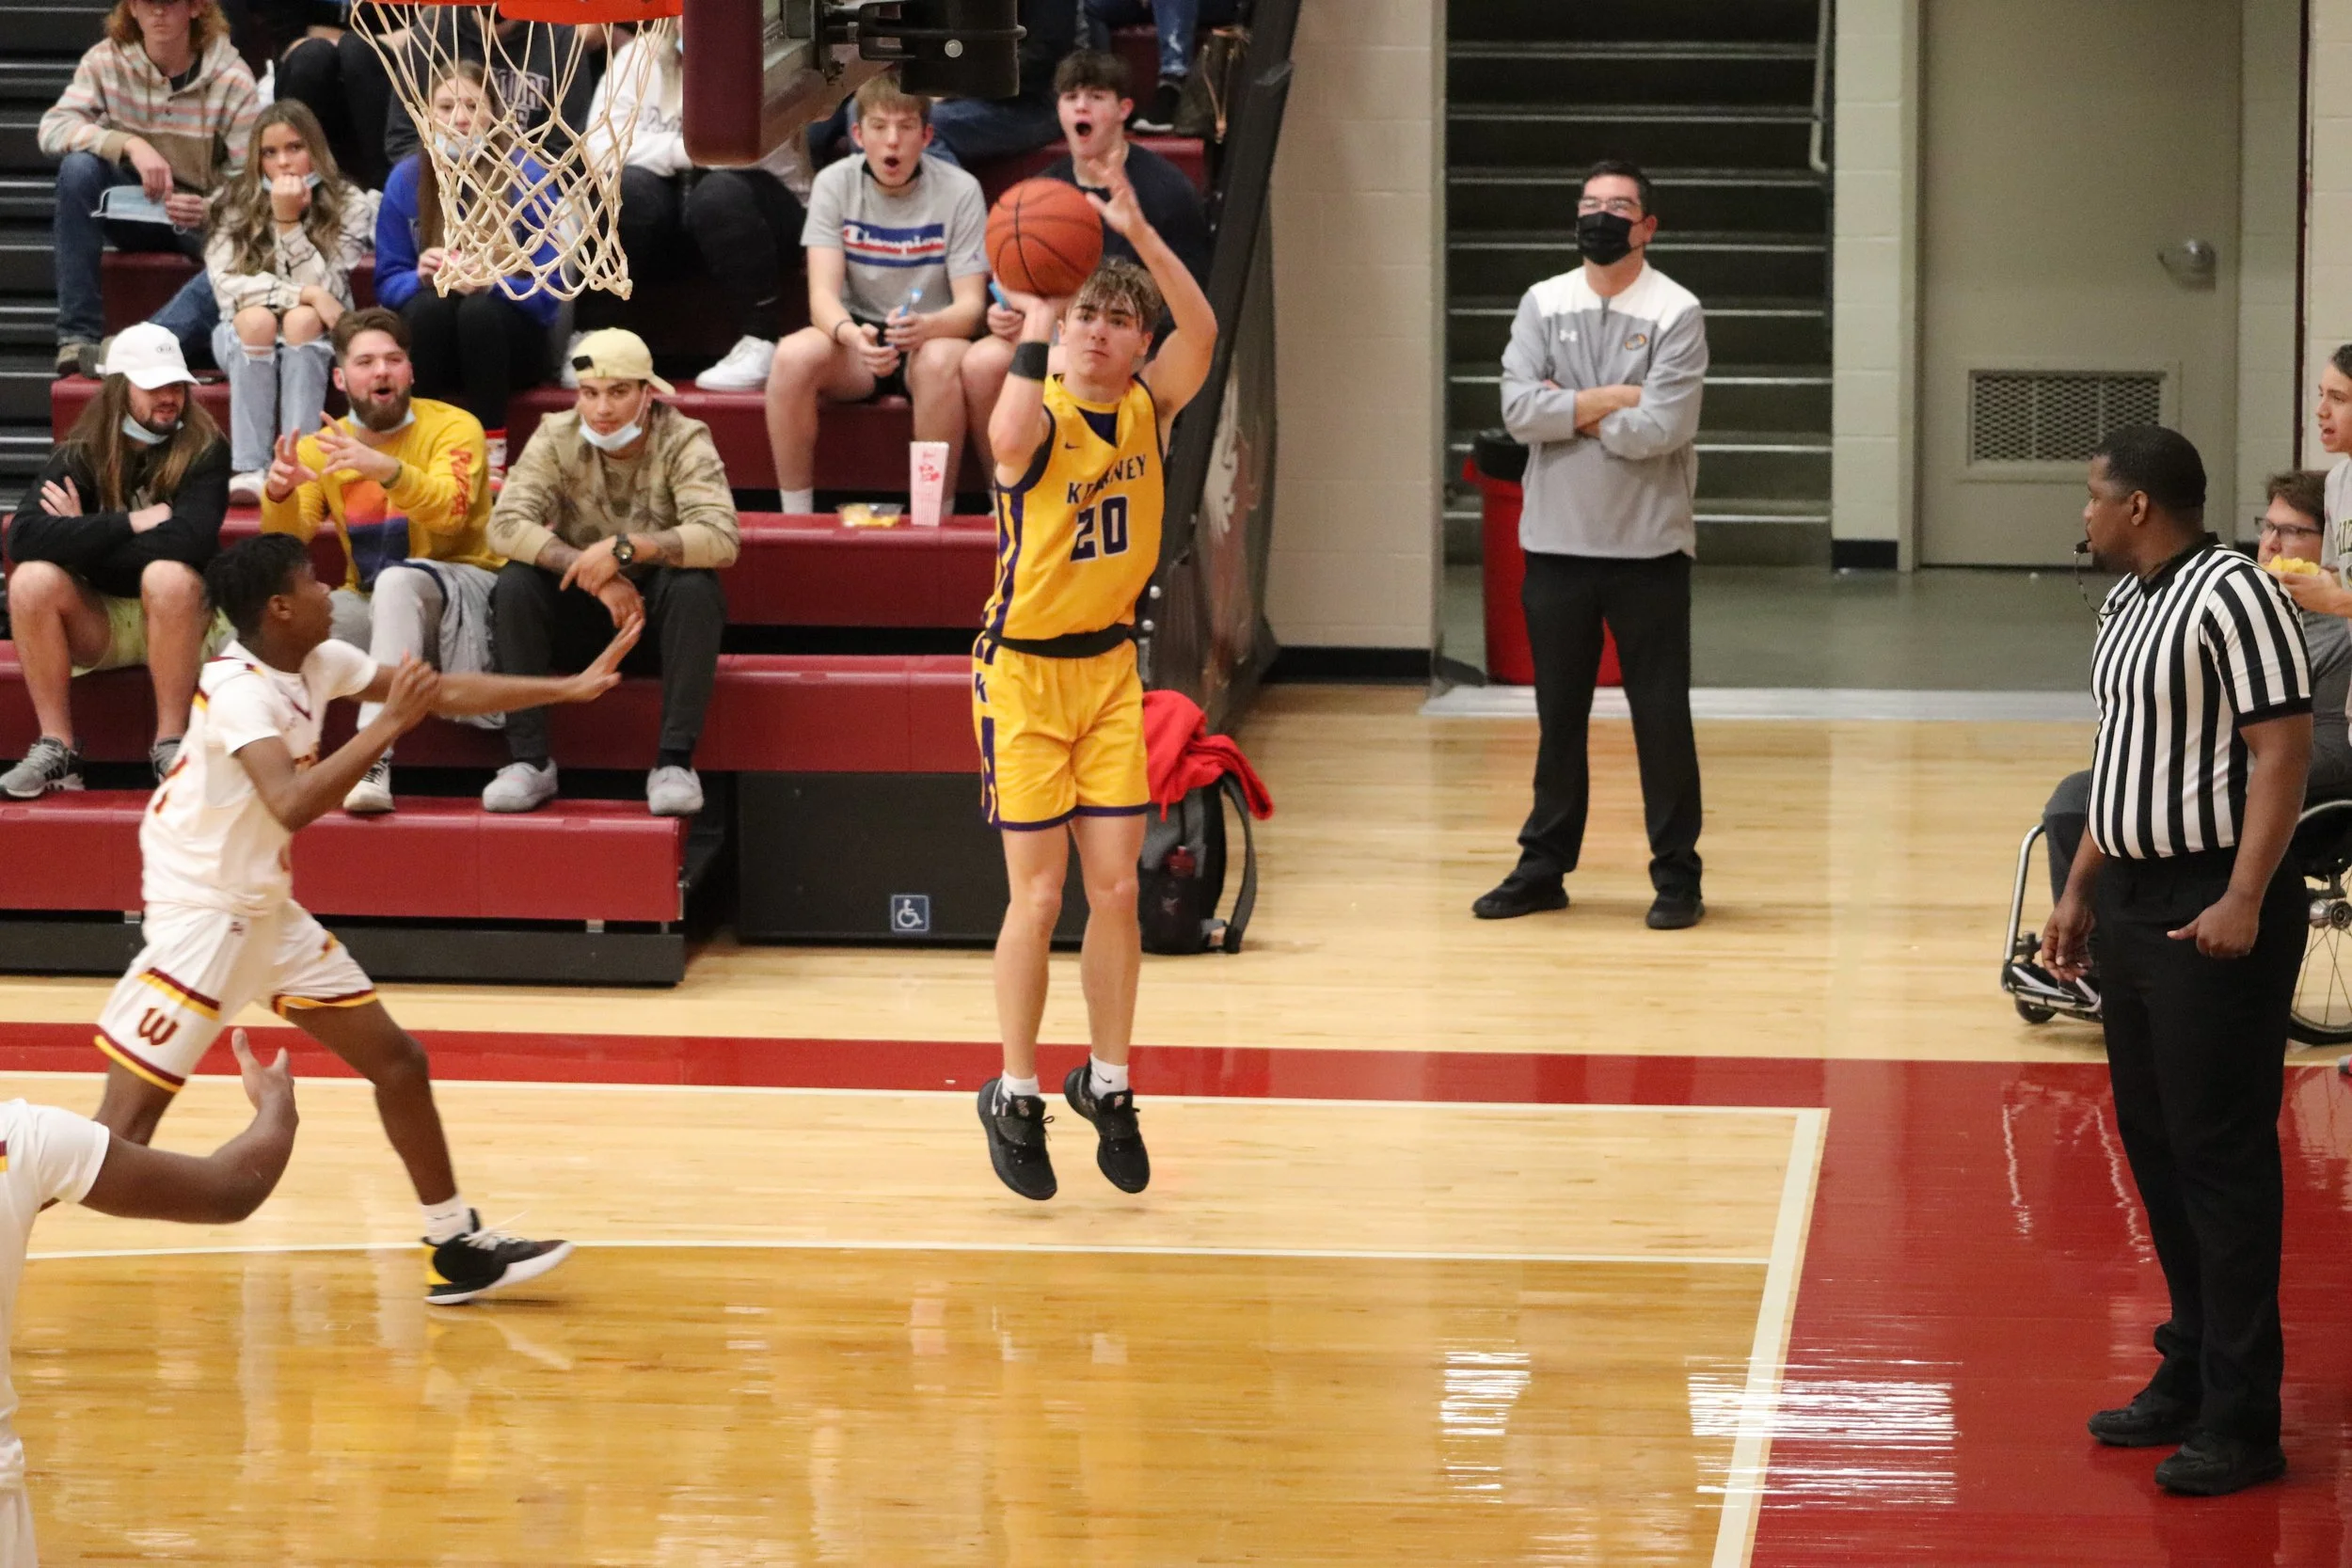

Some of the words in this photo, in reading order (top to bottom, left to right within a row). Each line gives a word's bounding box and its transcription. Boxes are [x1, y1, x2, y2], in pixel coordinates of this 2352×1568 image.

[1066, 453, 1147, 504] KENEY
[1069, 494, 1129, 562] 20
[975, 672, 988, 703] K
[137, 1006, 179, 1046] W
